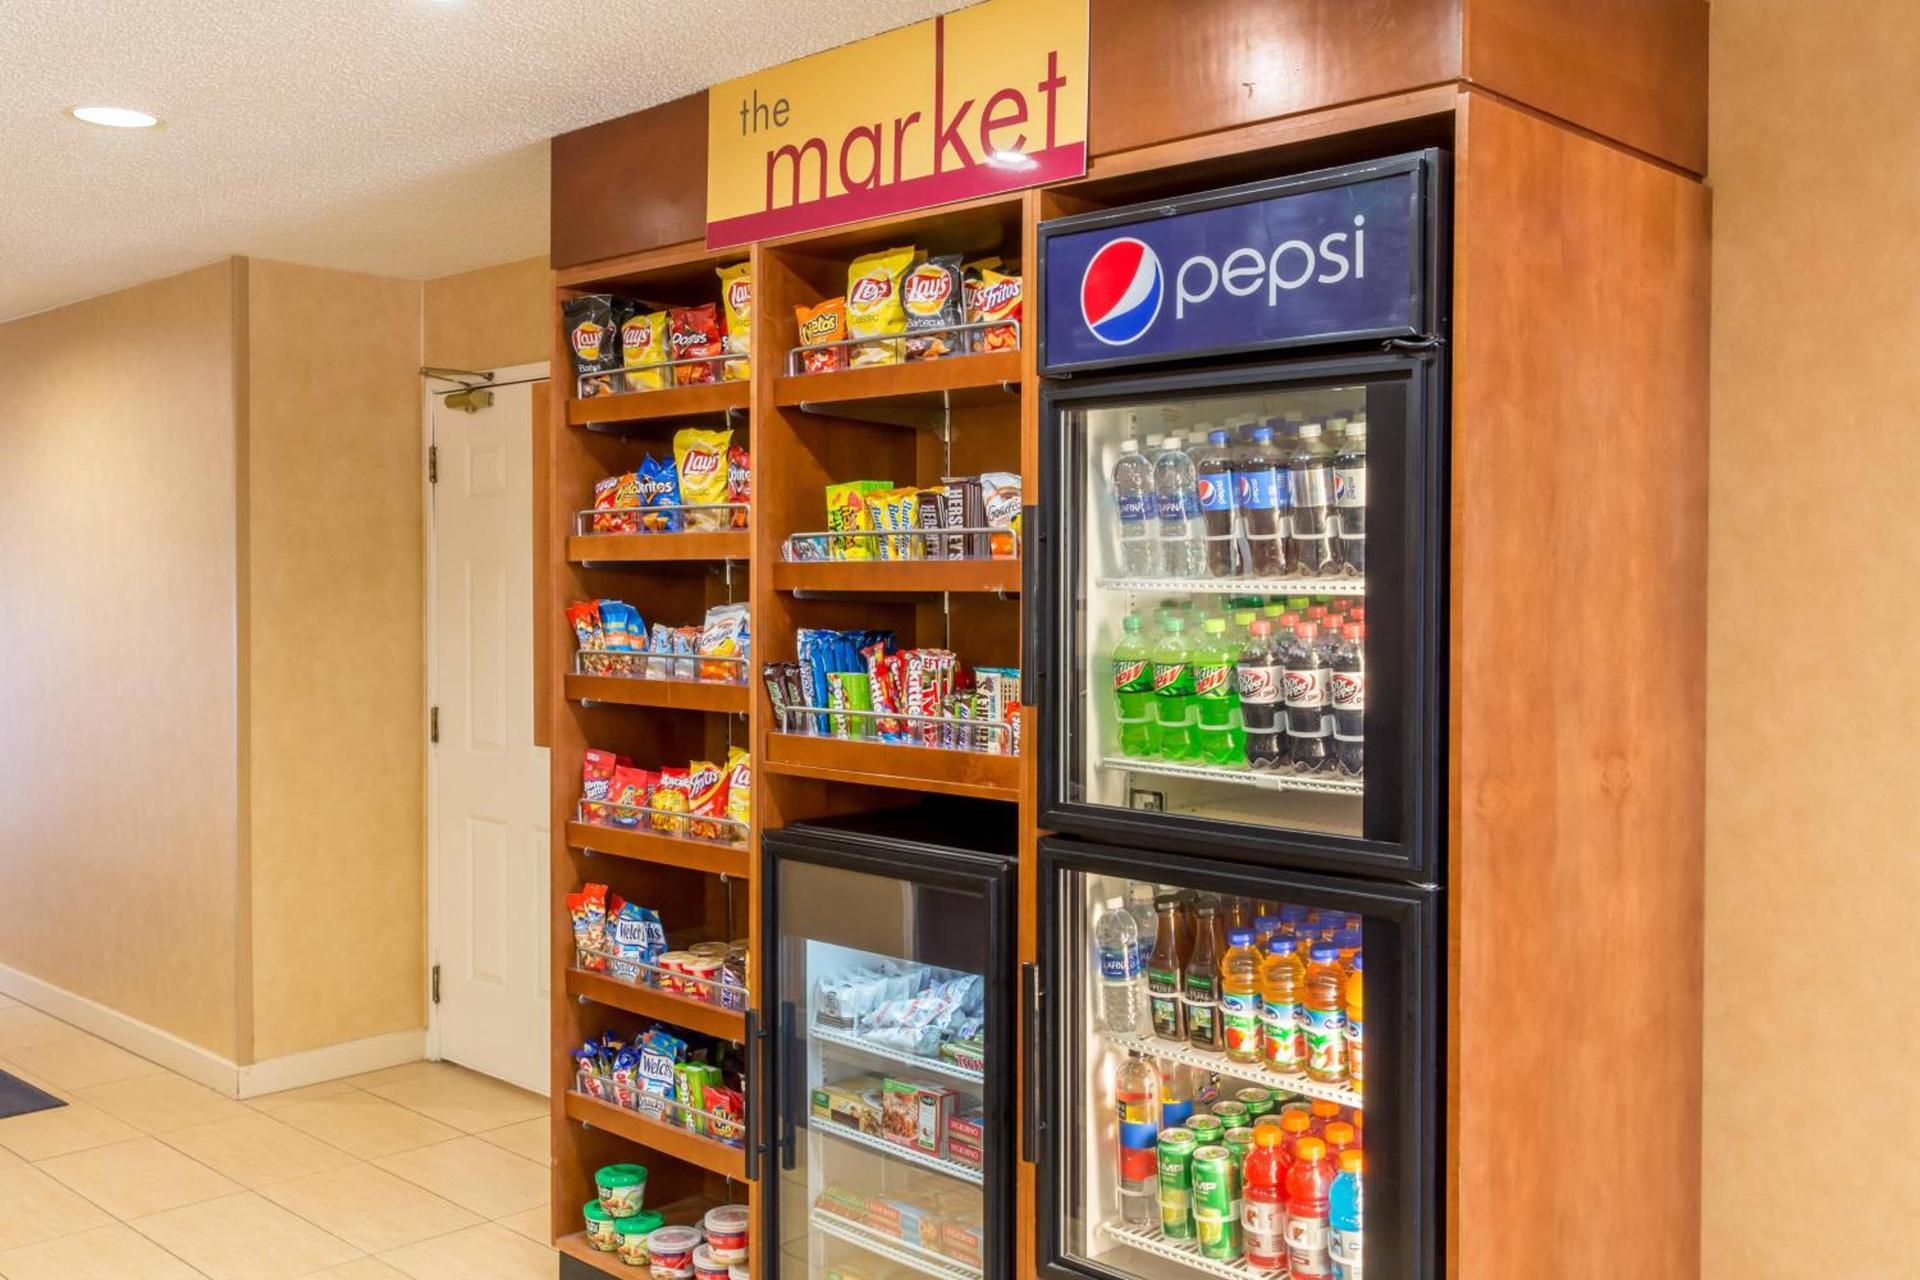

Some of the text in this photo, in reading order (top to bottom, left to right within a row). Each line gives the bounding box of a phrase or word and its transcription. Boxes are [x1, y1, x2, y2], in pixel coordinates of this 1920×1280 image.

[740, 89, 790, 136] the
[766, 15, 1067, 211] market
[907, 272, 950, 303] Lay's
[1175, 214, 1365, 320] pepsi
[982, 281, 1021, 312] Fritos
[684, 450, 720, 475] Lay's
[907, 659, 922, 727] Skittles
